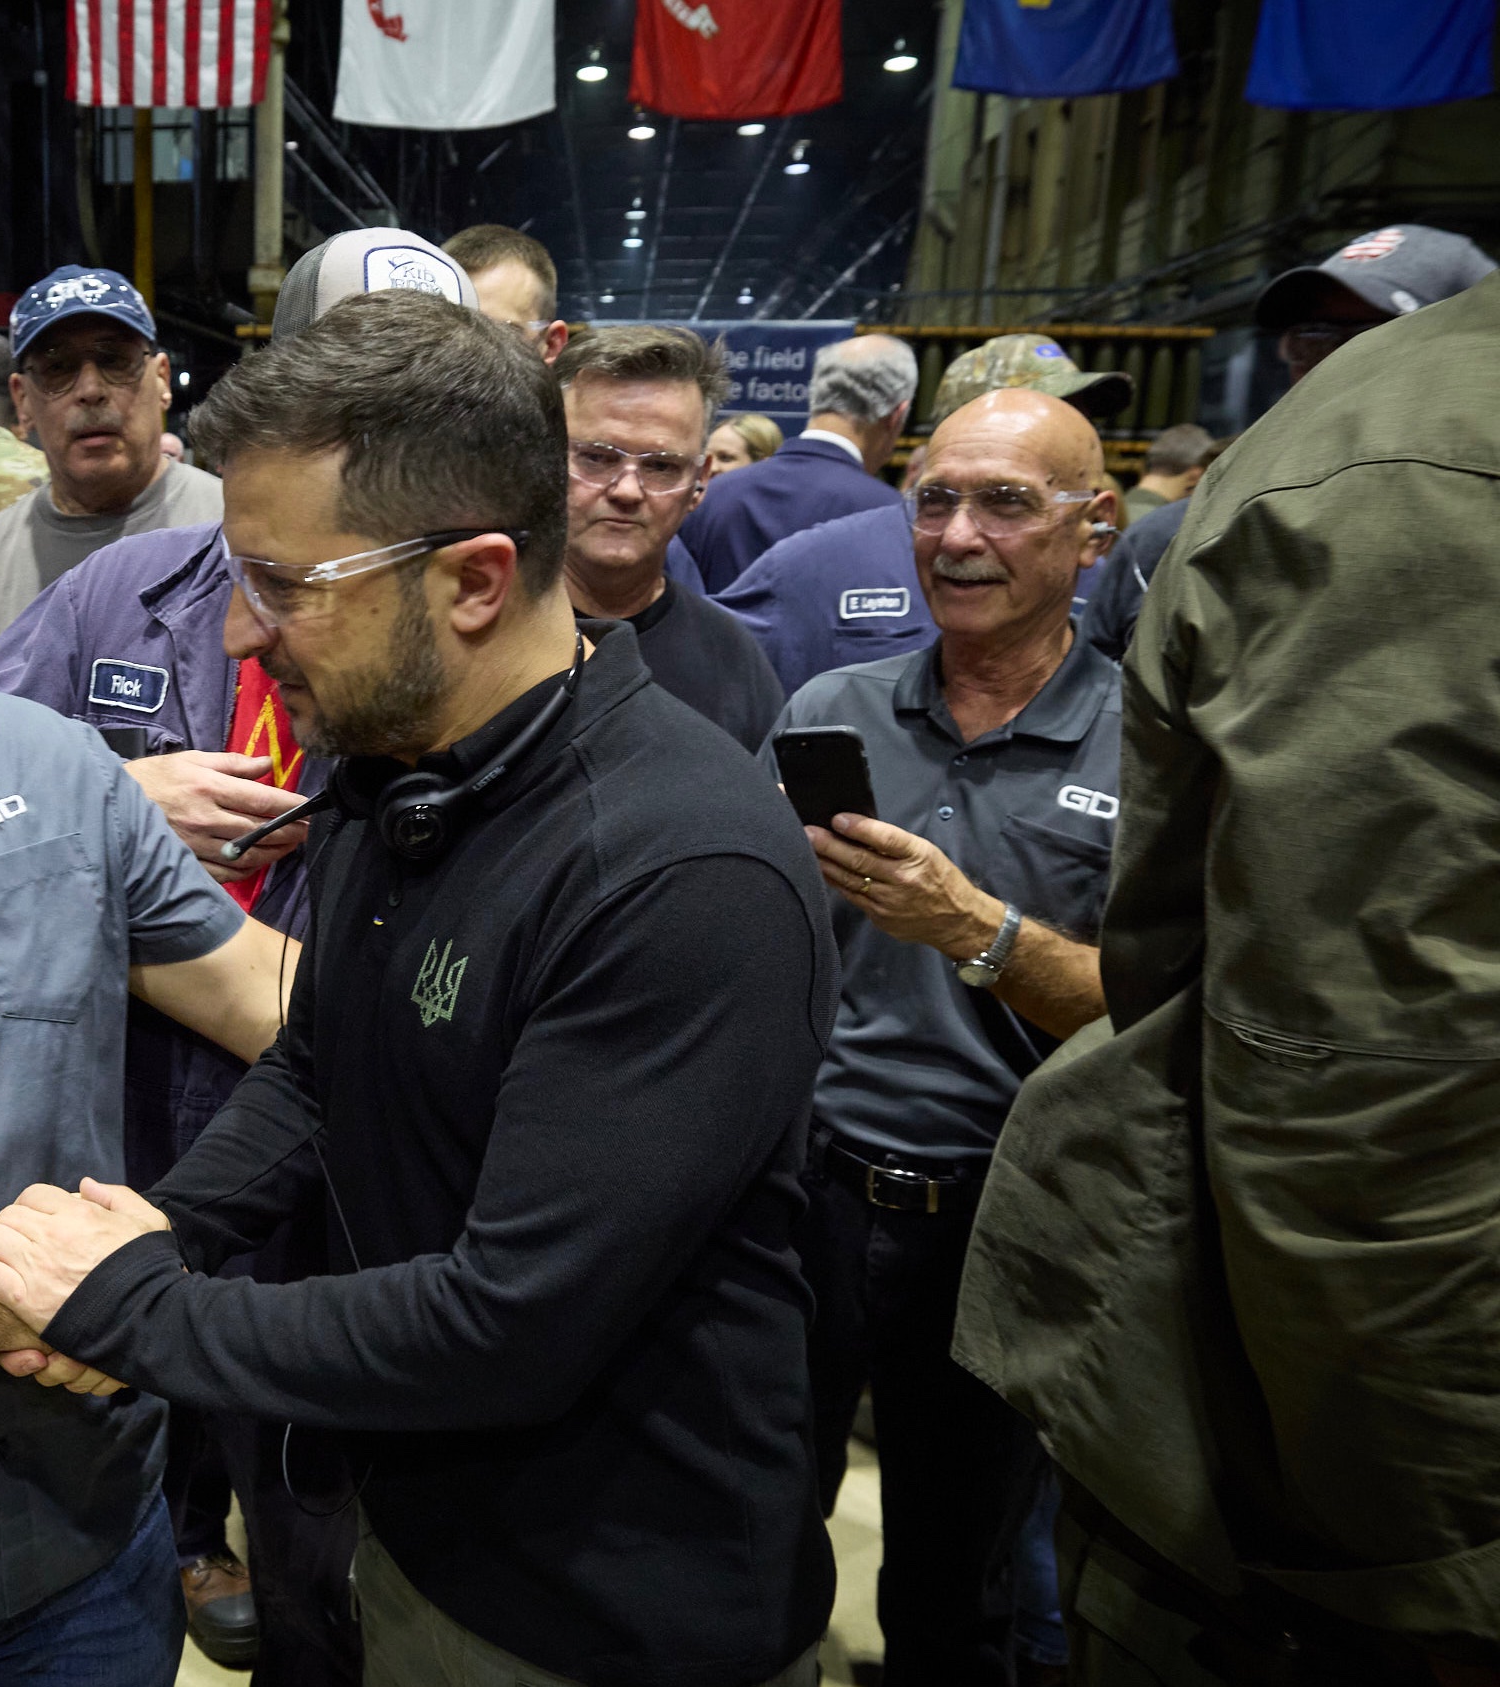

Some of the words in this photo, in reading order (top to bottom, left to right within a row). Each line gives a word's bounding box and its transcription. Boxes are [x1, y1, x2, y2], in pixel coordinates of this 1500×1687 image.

[754, 345, 807, 371] field
[747, 376, 811, 401] facto
[110, 674, 143, 698] Rick
[1057, 784, 1120, 820] GD
